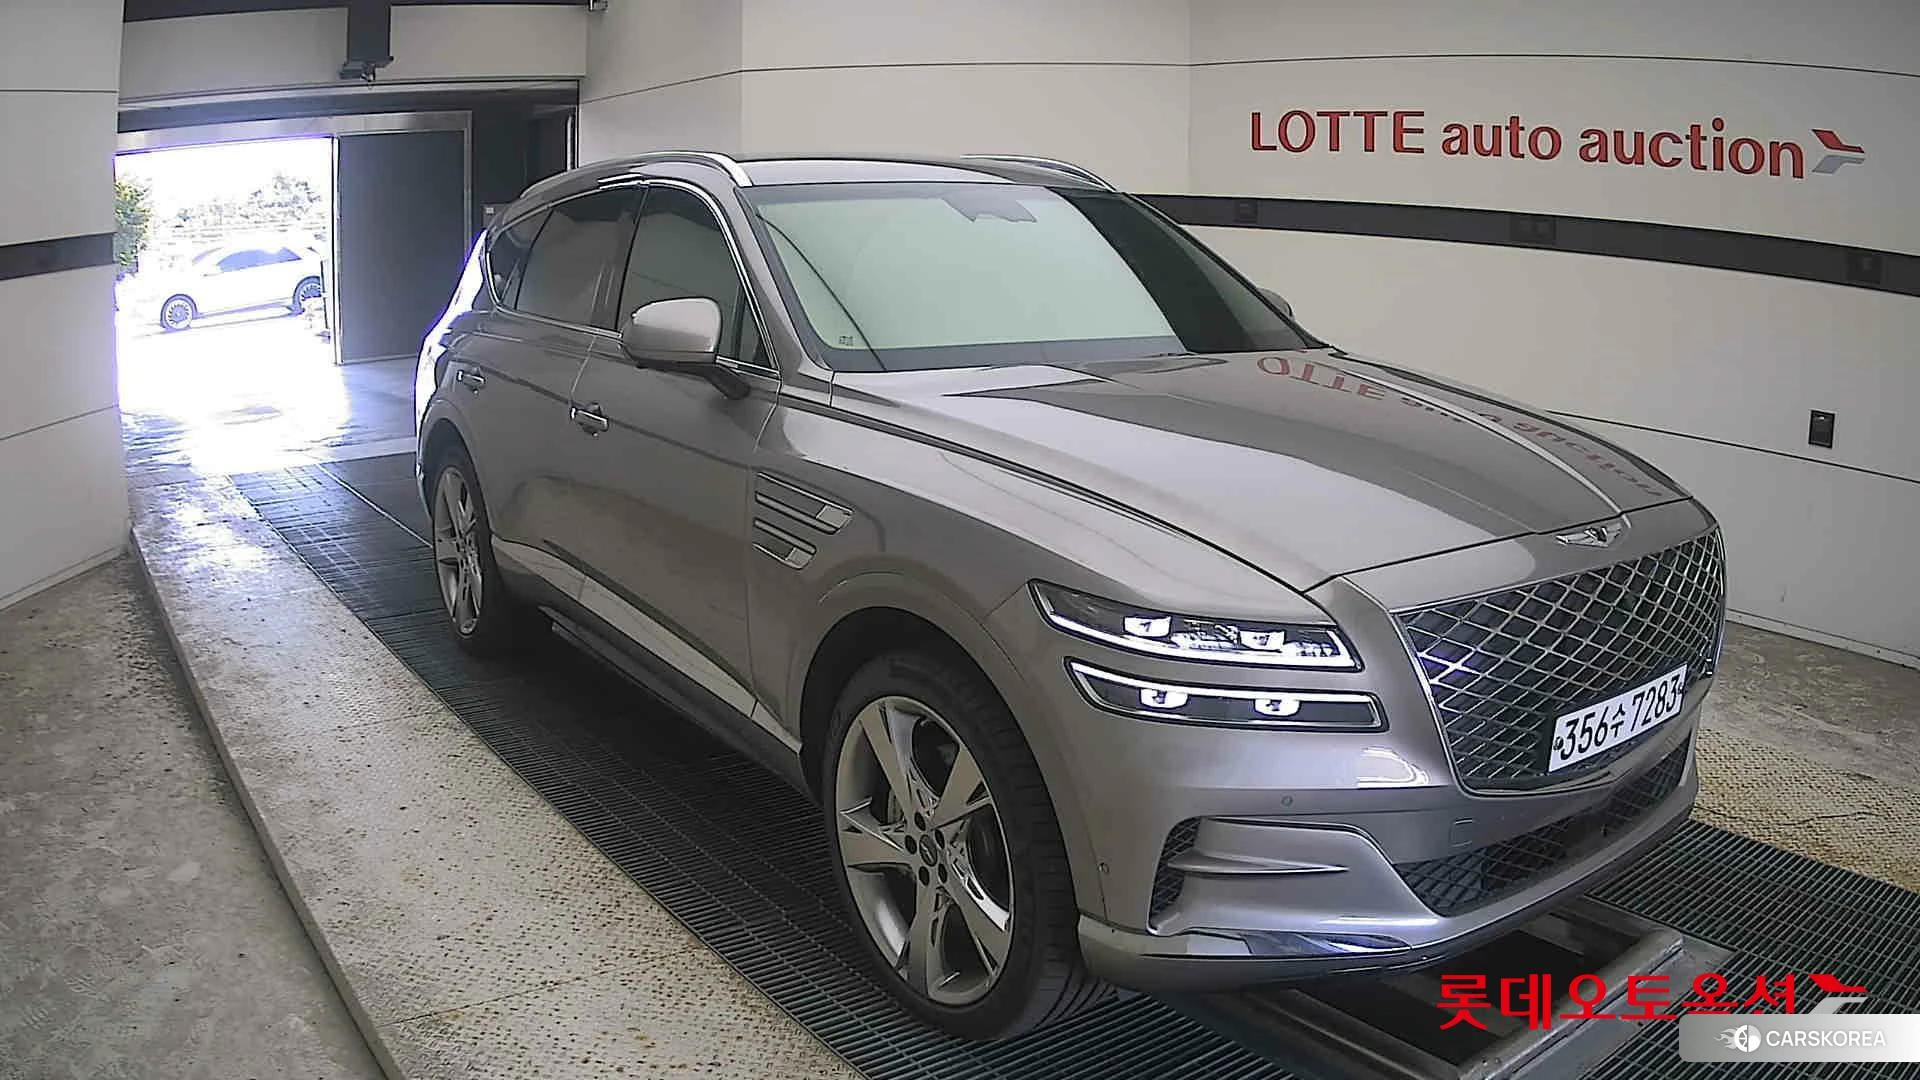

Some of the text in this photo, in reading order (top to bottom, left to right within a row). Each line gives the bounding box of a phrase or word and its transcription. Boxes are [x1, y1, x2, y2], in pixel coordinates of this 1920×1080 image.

[1250, 109, 1805, 180] LOTTE auto auction
[1560, 674, 1681, 761] 356수 7283
